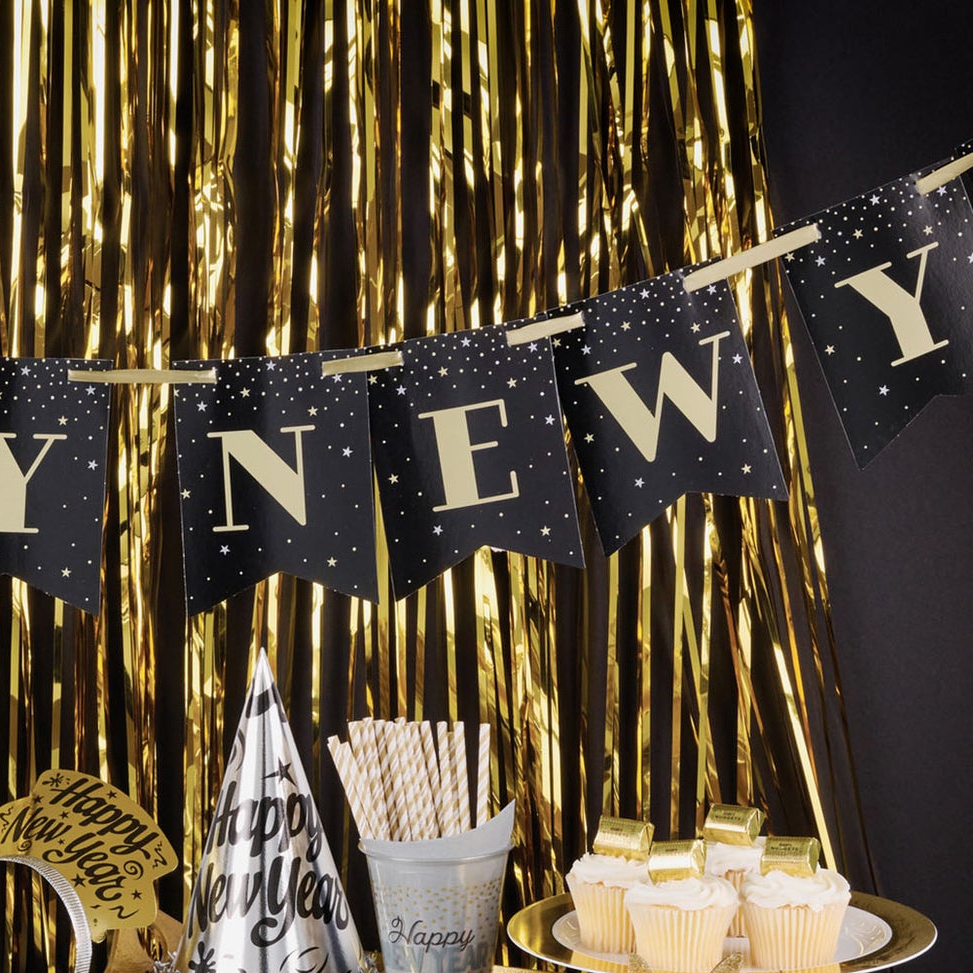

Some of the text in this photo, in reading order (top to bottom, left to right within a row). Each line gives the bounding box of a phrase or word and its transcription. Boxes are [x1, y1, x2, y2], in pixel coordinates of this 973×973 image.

[207, 331, 731, 534] NEW
[0, 806, 127, 901] New Year
[49, 778, 160, 860] Happy
[207, 780, 323, 863] Happy
[188, 856, 349, 948] New Year
[388, 916, 476, 953] Happy
